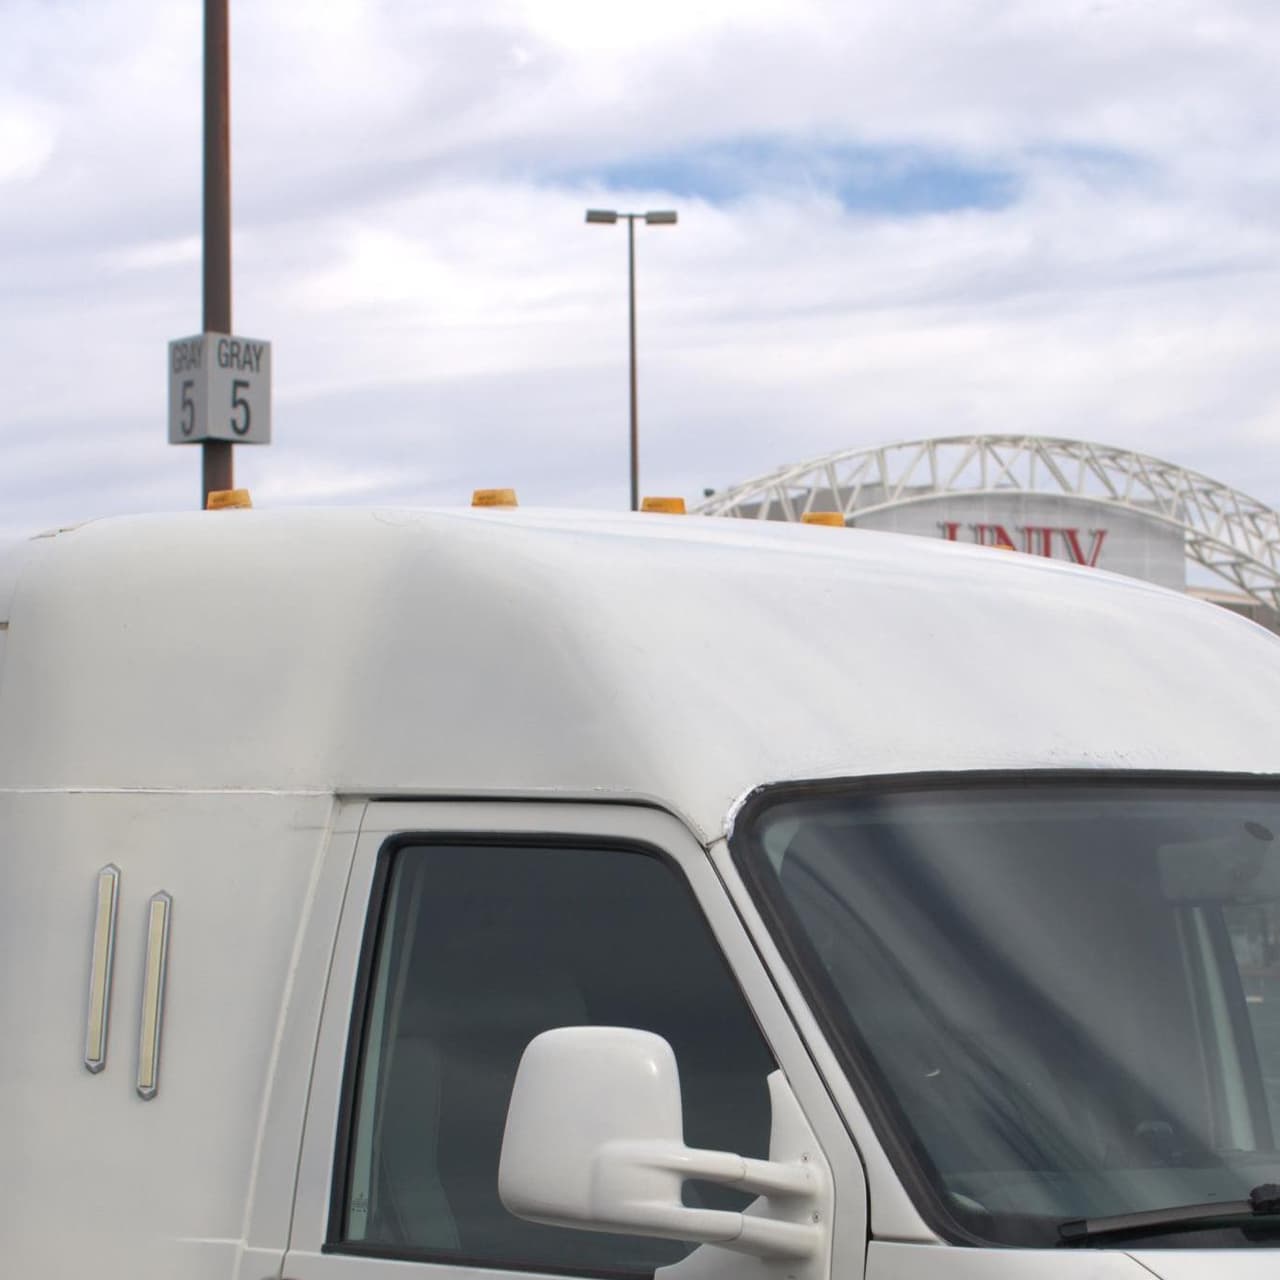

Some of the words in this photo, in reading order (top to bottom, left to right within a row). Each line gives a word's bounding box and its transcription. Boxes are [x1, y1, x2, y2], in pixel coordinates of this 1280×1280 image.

[173, 342, 203, 374] GRAY
[217, 339, 263, 373] GRAY
[181, 380, 195, 436] 5
[230, 379, 251, 436] 5
